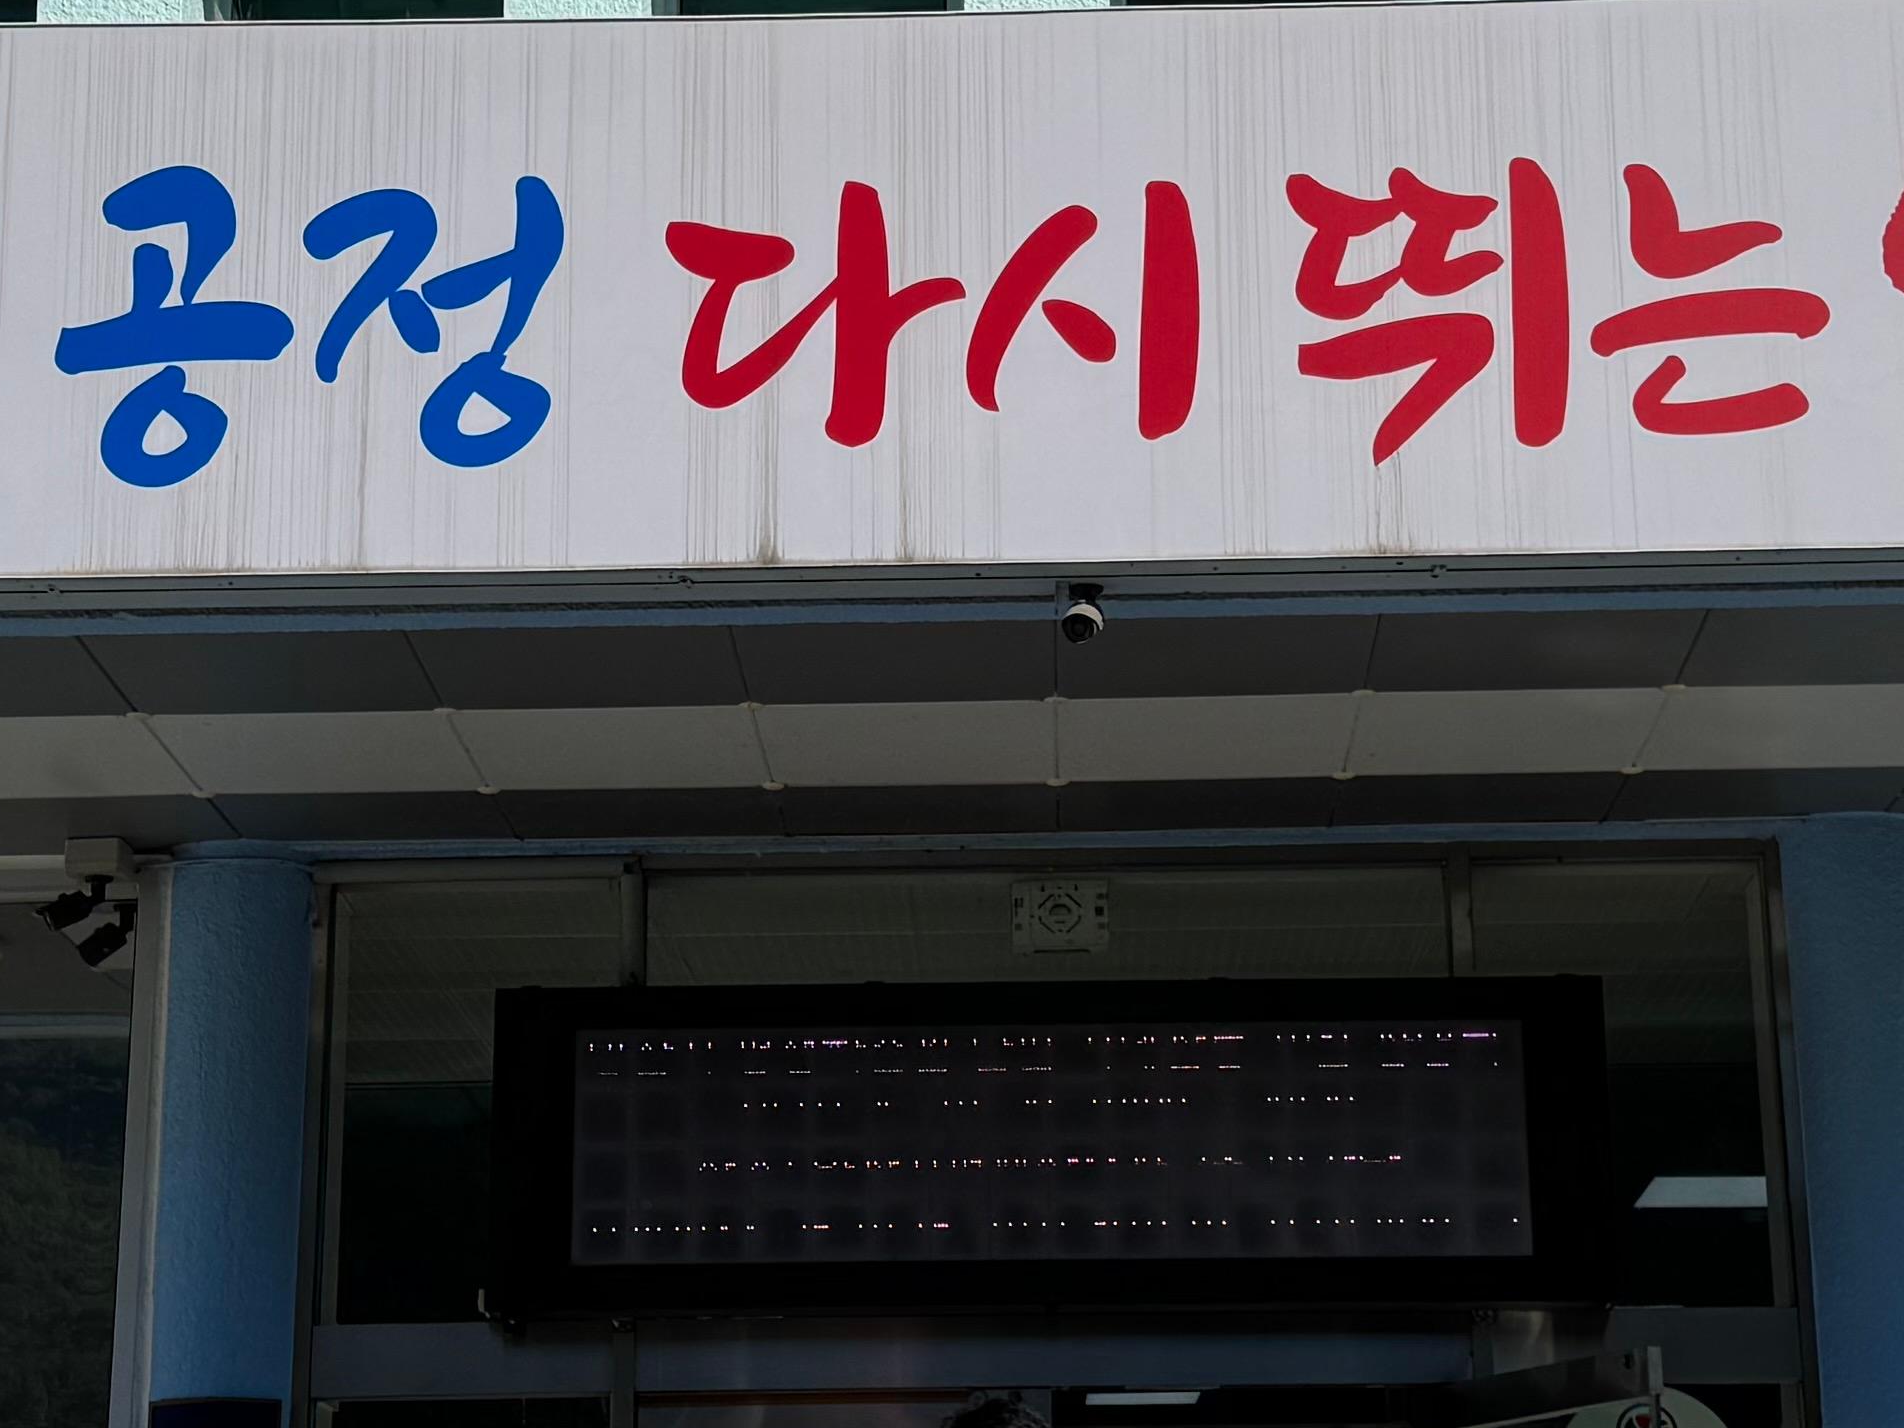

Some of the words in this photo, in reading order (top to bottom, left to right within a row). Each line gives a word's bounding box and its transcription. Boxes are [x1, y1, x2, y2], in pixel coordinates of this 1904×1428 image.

[55, 166, 564, 487] 공정
[666, 181, 1199, 447] 다시
[1287, 158, 1829, 463] 뛰는
